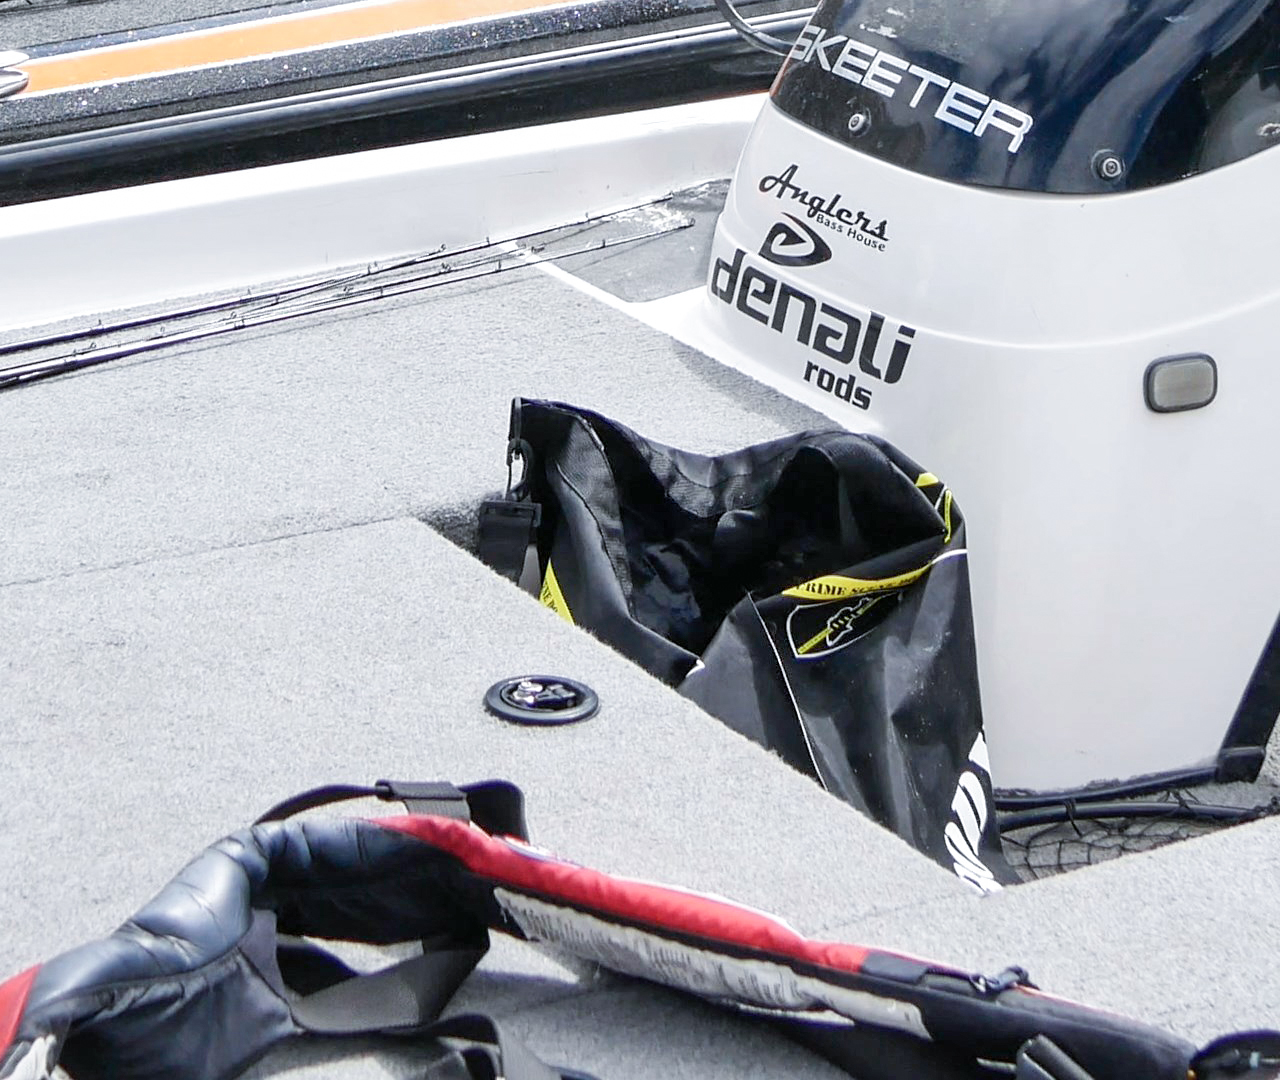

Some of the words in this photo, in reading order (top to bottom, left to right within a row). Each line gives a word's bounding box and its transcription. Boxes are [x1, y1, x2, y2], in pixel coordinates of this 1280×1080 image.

[791, 24, 1034, 153] SKEETER
[759, 163, 891, 242] Anglers
[816, 212, 844, 236] Bass
[846, 226, 887, 253] House
[711, 247, 917, 384] denali
[803, 360, 873, 411] rods
